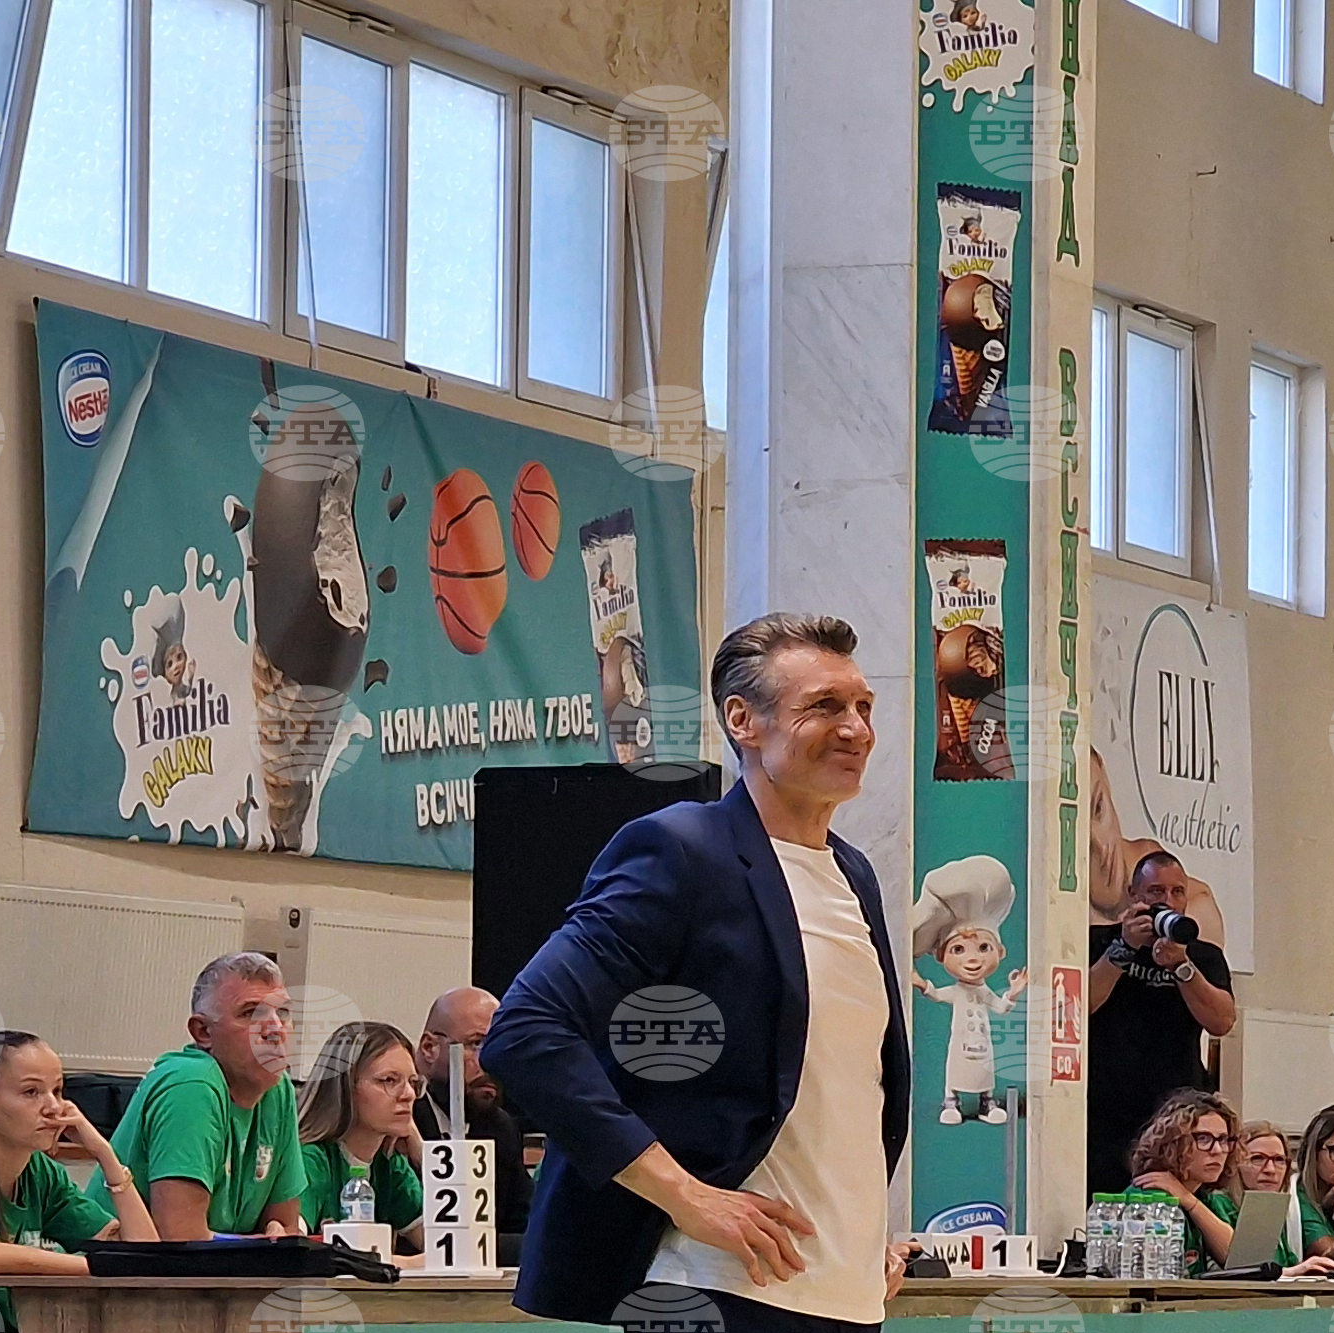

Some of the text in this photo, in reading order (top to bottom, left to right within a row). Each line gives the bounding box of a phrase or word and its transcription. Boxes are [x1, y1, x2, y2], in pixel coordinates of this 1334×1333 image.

[934, 22, 1018, 54] Familia
[944, 49, 1002, 82] GALAXY
[947, 237, 1008, 259] Familia
[938, 588, 997, 609] Familia
[132, 678, 230, 748] Familia
[380, 706, 442, 754] НЯМА
[443, 702, 486, 751] МОЕ,
[545, 693, 599, 742] ТВОЕ,
[1158, 669, 1220, 784] ELLY
[143, 735, 214, 808] GALAXY
[431, 1144, 455, 1180] 3
[472, 1144, 487, 1179] 3
[434, 1188, 459, 1223] 2
[474, 1188, 489, 1222] 2
[938, 1210, 993, 1234] ICE CREAM
[436, 1232, 454, 1267] 1
[478, 1232, 487, 1267] 1
[992, 1240, 1008, 1267] 1
[1026, 1240, 1033, 1267] 1
